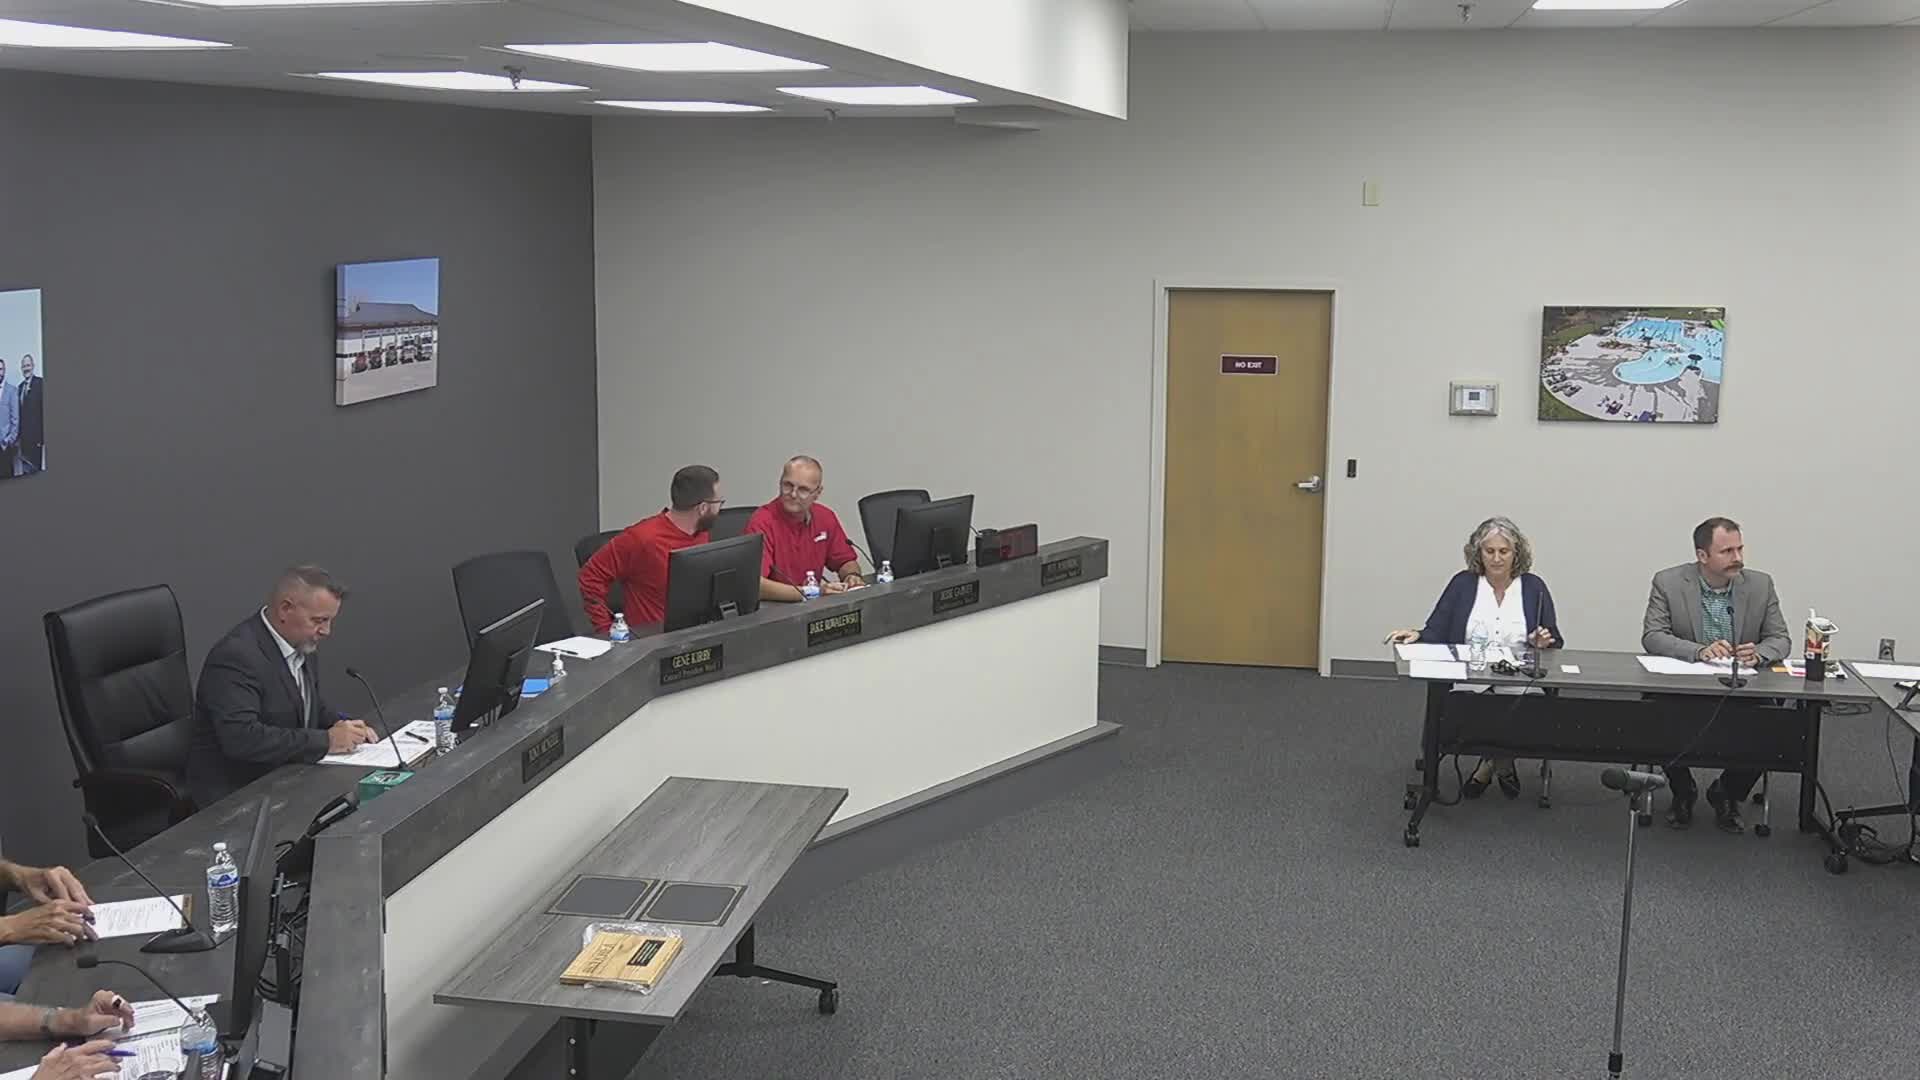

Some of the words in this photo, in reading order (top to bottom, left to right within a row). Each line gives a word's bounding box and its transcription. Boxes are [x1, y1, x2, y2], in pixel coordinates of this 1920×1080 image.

[1235, 361, 1246, 369] NO
[1247, 361, 1263, 369] EXIT
[672, 653, 690, 668] GENE
[691, 648, 711, 664] KIRBY
